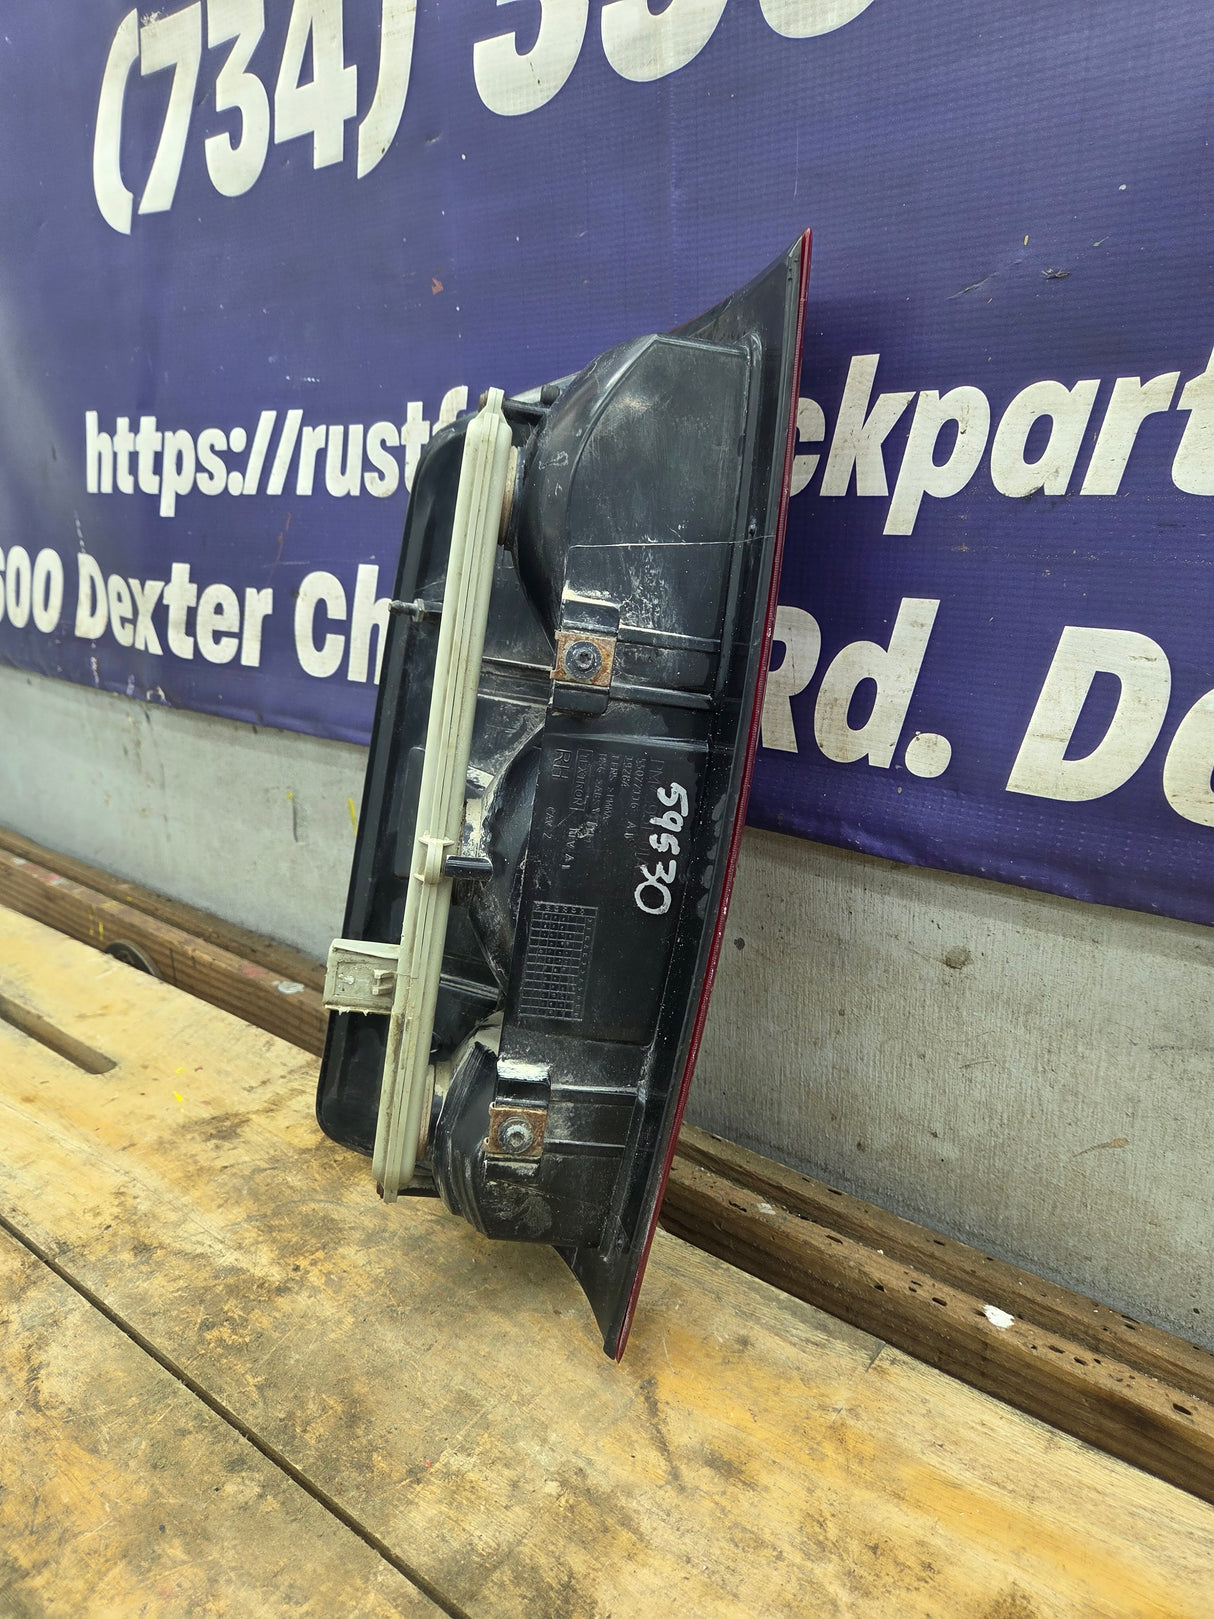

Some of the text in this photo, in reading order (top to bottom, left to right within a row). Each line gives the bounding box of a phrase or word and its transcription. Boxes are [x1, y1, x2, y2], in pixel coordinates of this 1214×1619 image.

[93, 0, 417, 234] (734)
[0, 545, 64, 633] 00
[75, 551, 273, 668] Dexter
[760, 598, 952, 778] Rd.
[551, 748, 572, 779] RH
[634, 782, 689, 915] 59530
